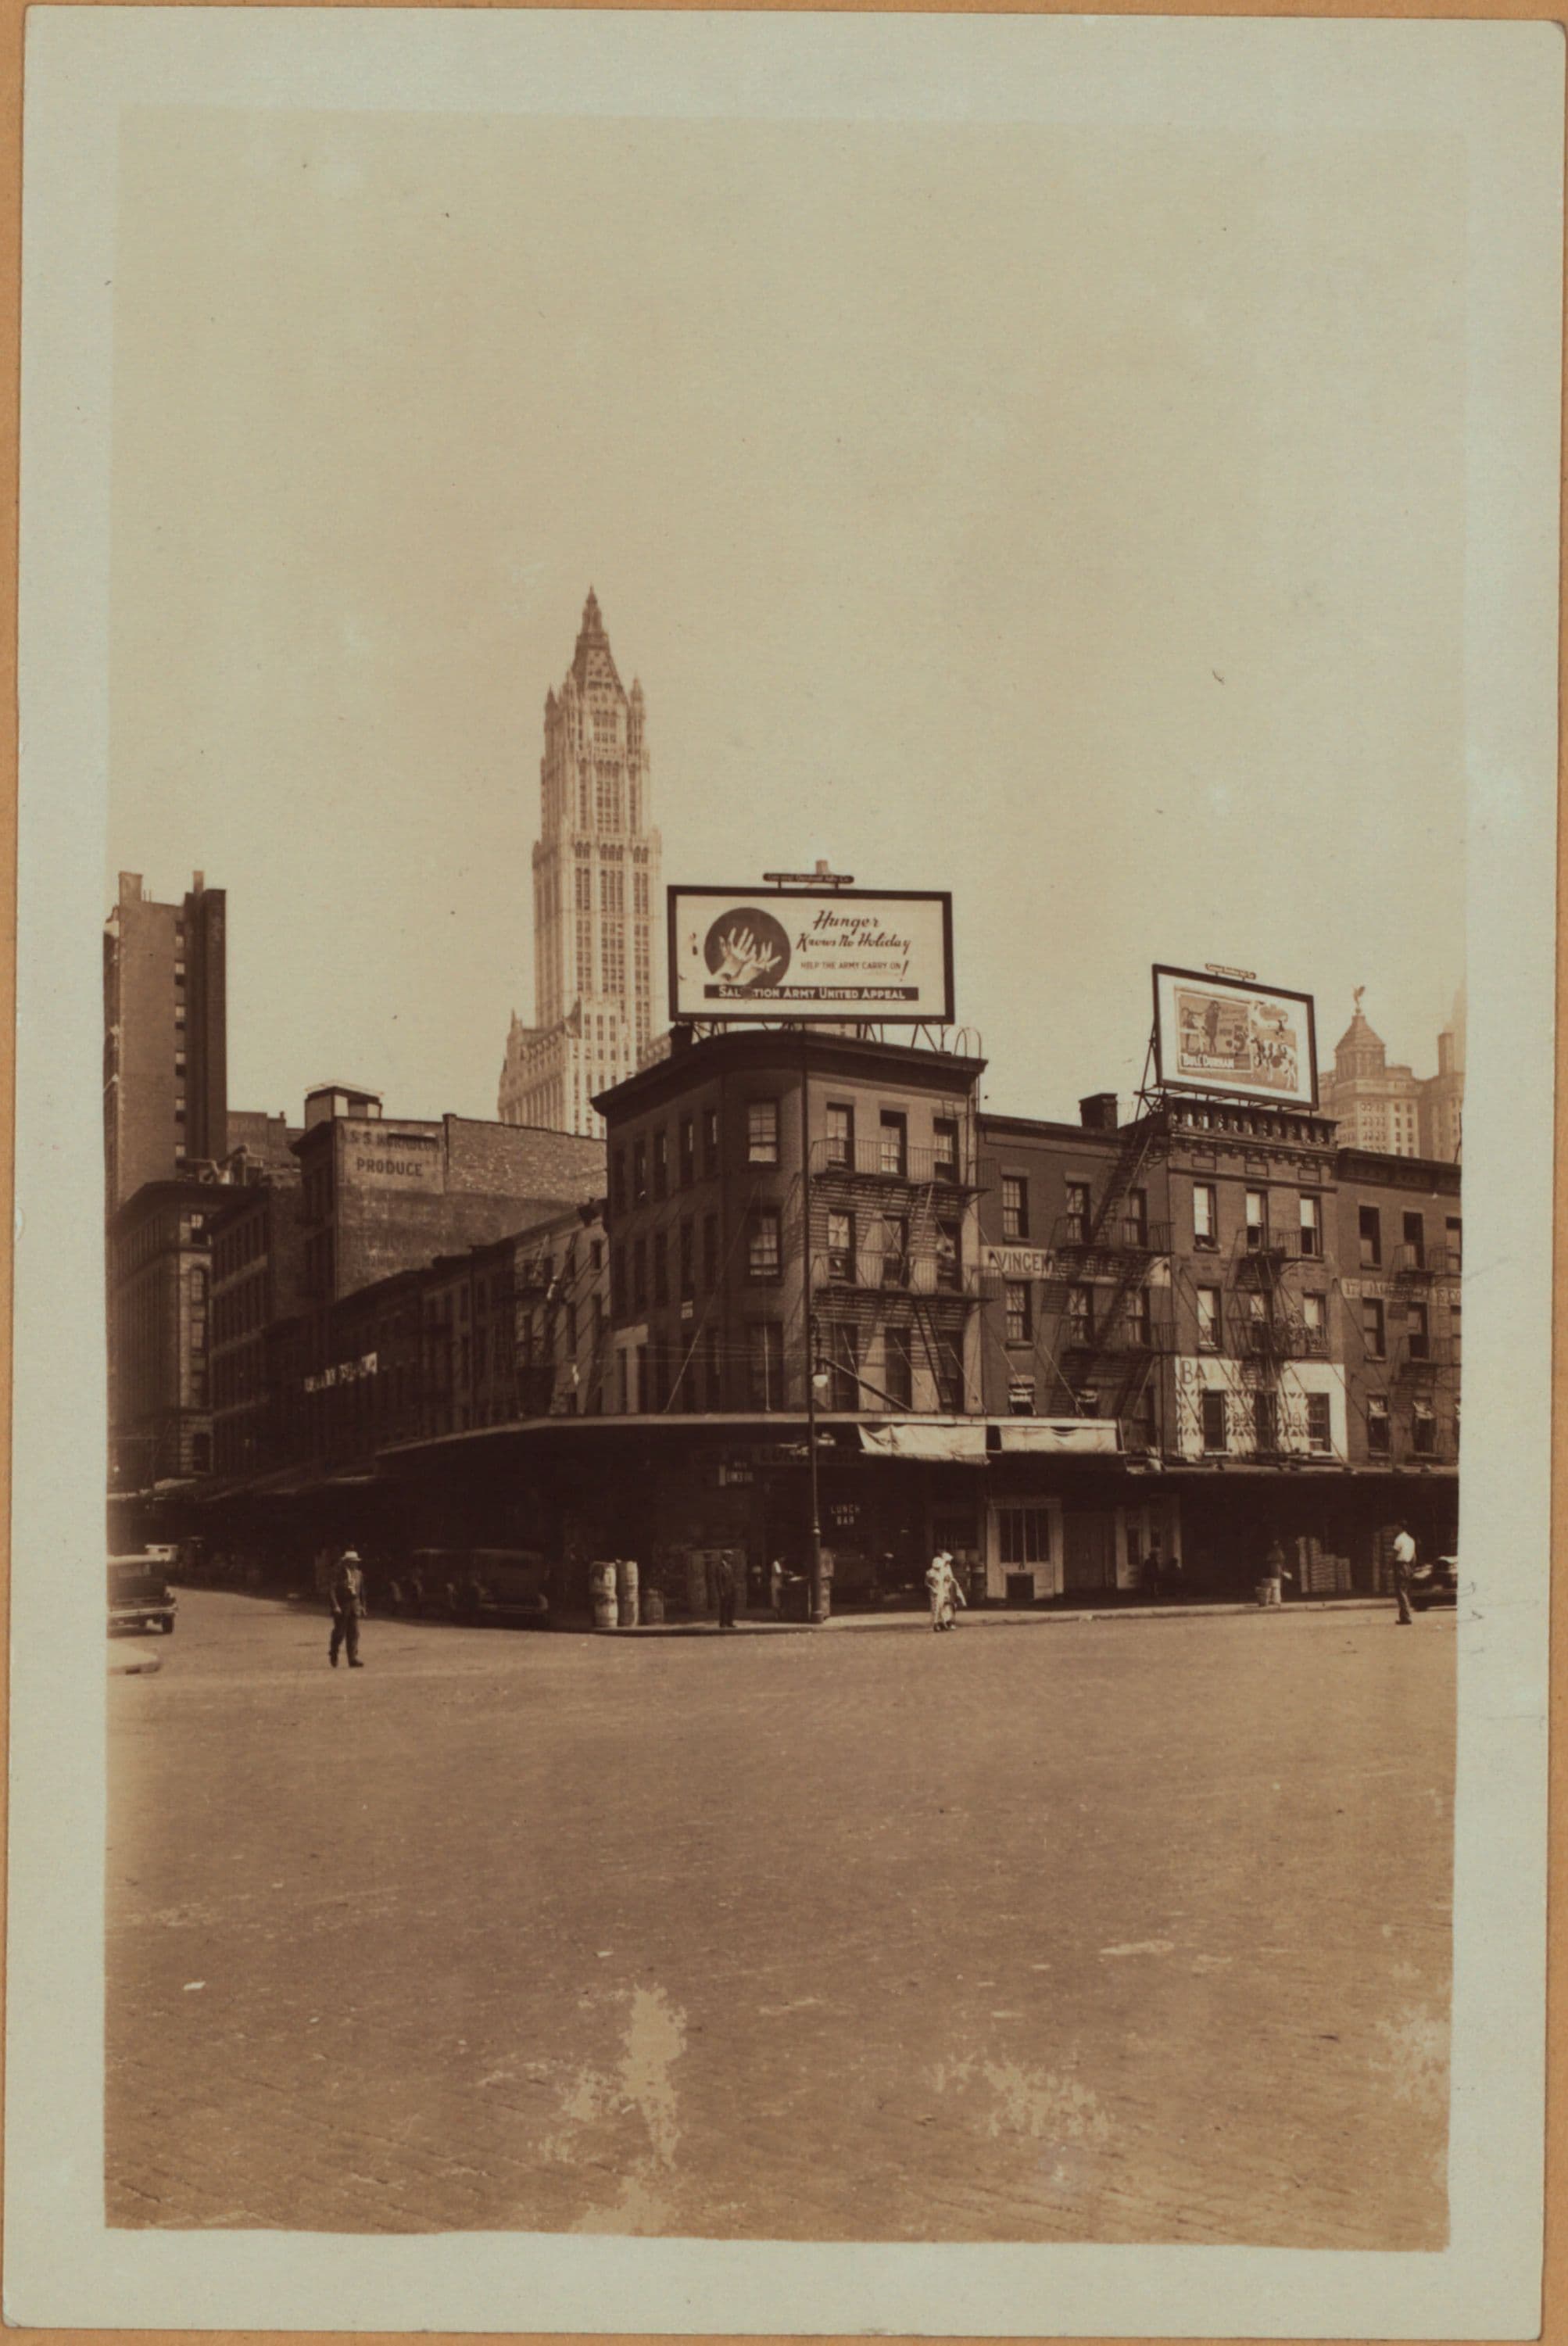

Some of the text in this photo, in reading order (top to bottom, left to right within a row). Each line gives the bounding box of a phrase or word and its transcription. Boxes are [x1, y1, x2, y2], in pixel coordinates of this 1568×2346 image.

[813, 909, 879, 936] Hunger
[796, 932, 911, 955] Knows No Holiday
[862, 962, 888, 970] CARRY
[783, 987, 816, 998] ARMY
[819, 987, 859, 1000] UNITED
[861, 988, 906, 1000] APPEAL
[356, 1157, 423, 1177] PRODUCE
[831, 1504, 860, 1514] LUNCH
[837, 1516, 854, 1525] BAR
